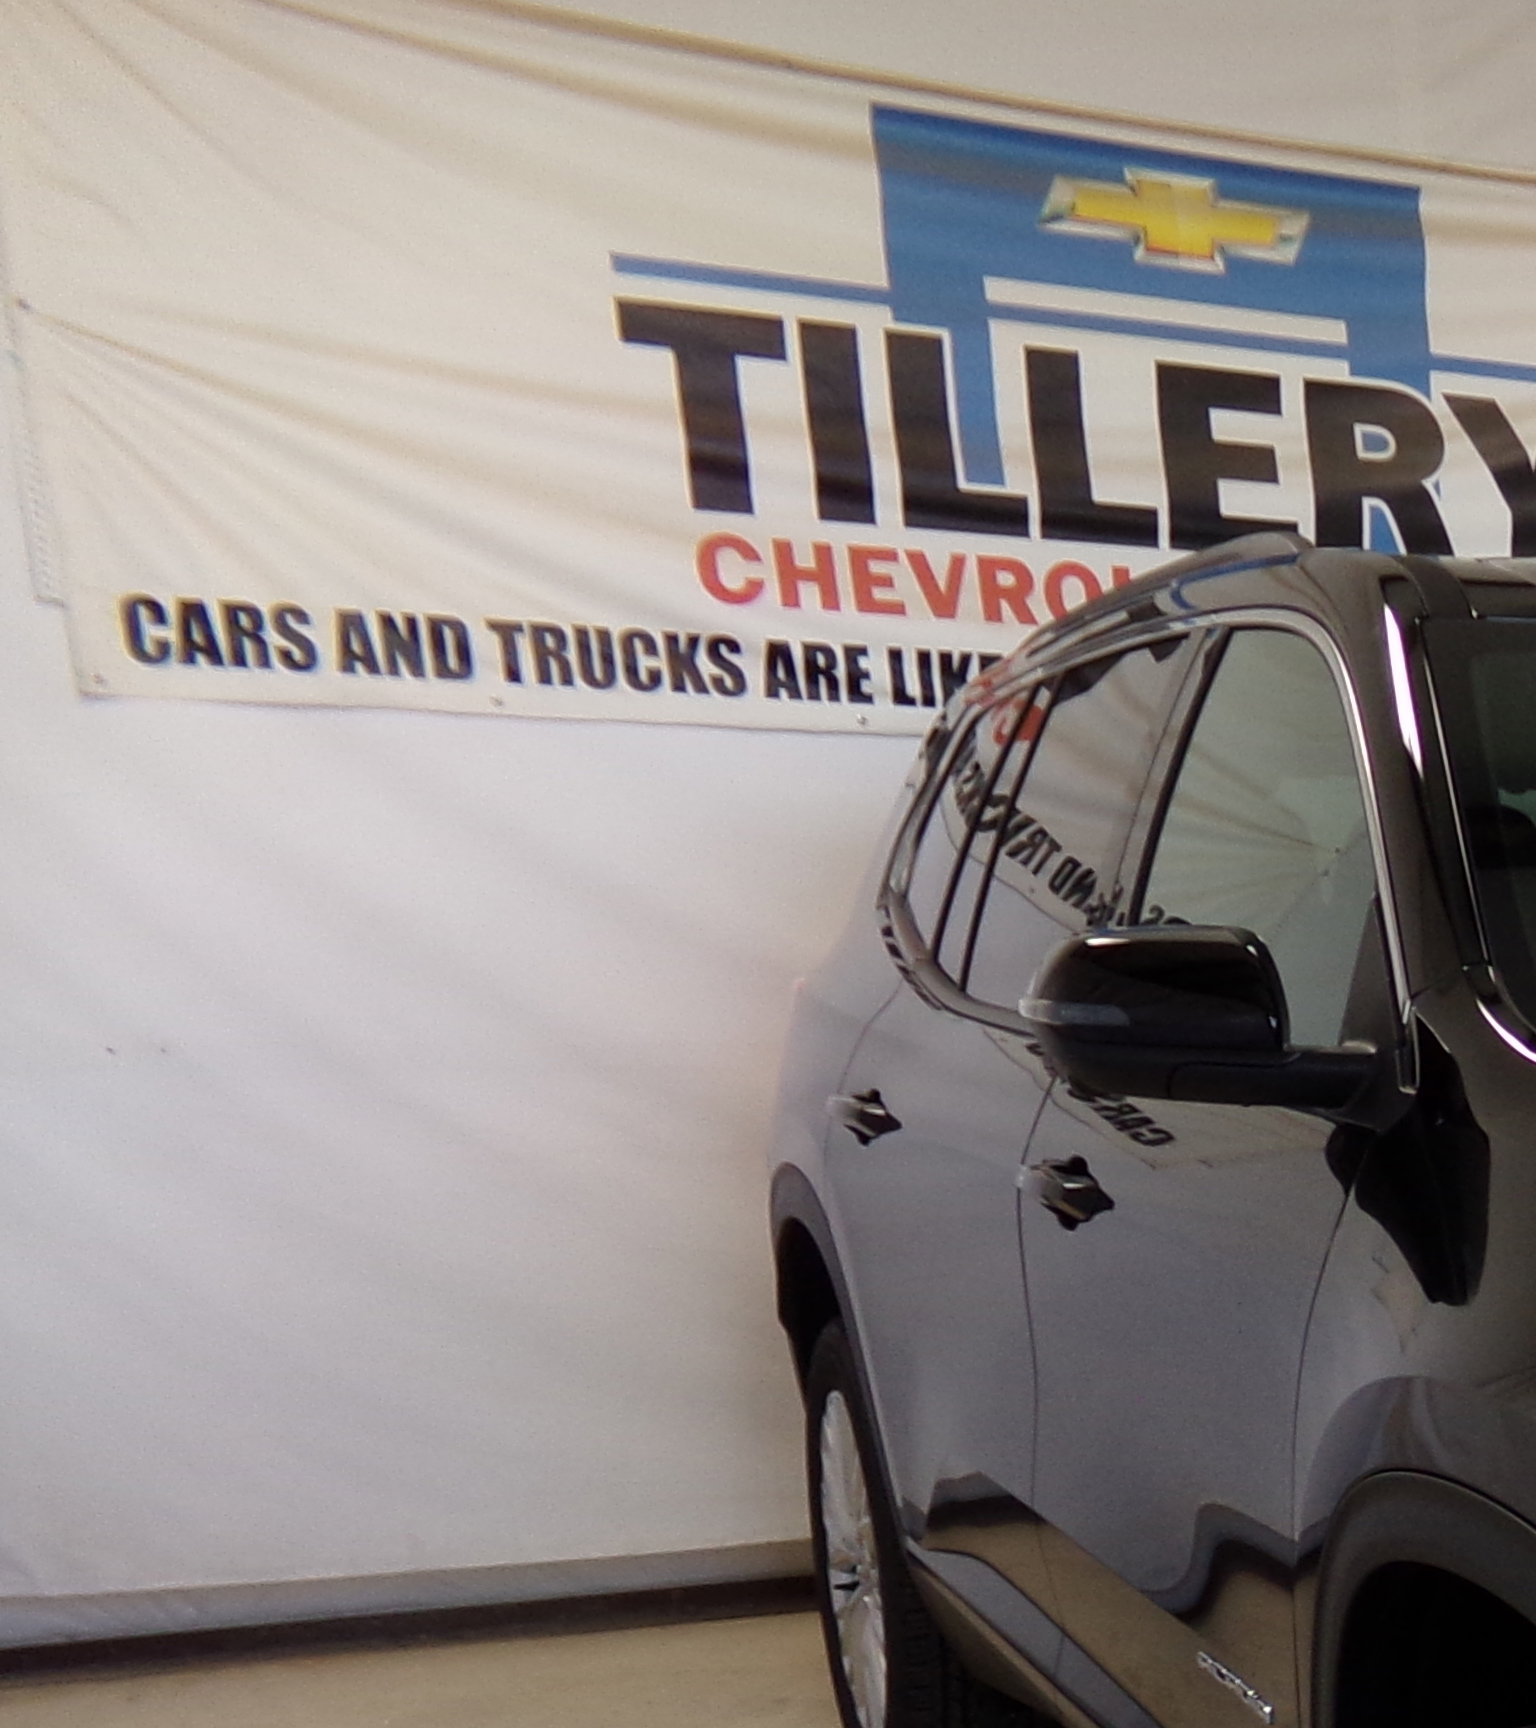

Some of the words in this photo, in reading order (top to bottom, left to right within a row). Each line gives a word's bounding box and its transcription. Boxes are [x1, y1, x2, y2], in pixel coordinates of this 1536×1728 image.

[118, 591, 320, 673] CARS
[333, 606, 475, 681] AND
[484, 617, 746, 697] TRUCKS
[763, 639, 876, 707] ARE
[886, 646, 1006, 708] LIK
